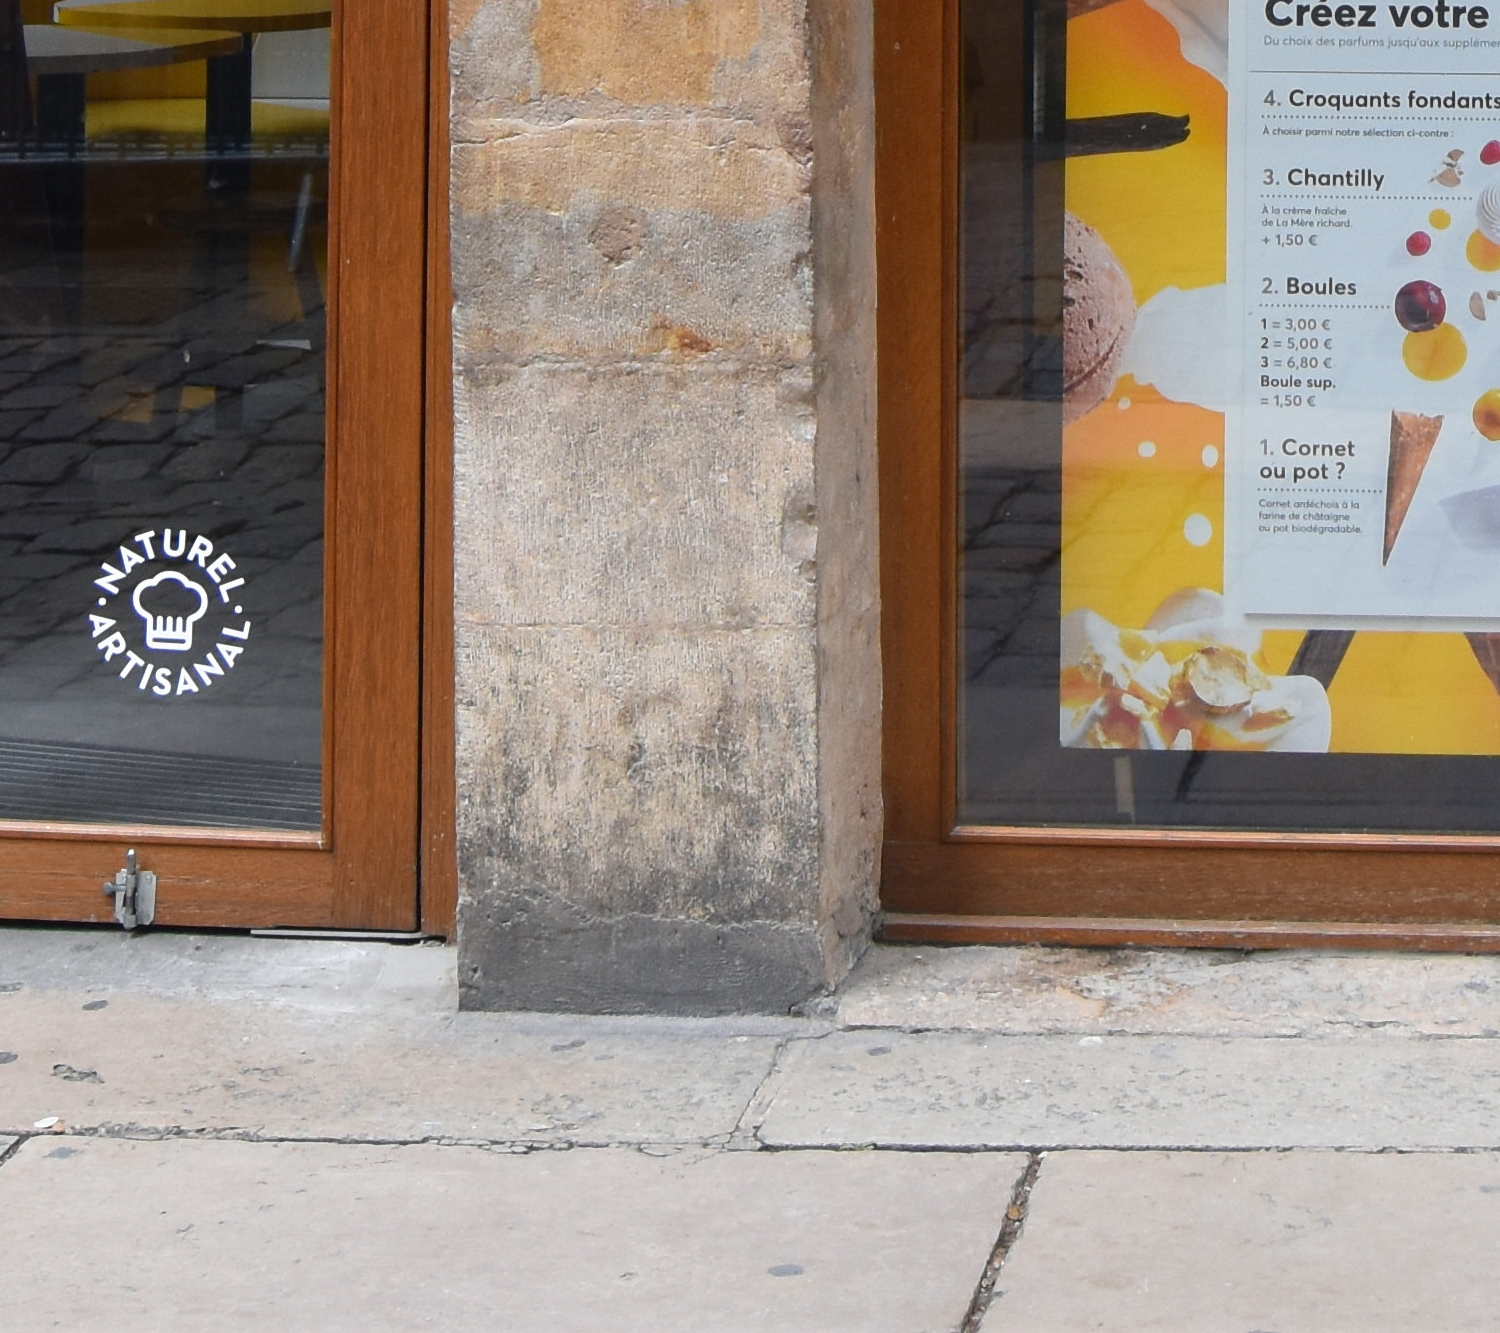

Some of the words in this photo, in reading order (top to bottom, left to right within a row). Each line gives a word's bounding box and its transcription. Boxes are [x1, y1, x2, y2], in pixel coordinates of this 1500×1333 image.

[1388, 0, 1489, 28] votre
[1263, 89, 1282, 107] 4.
[1288, 88, 1401, 112] Croquants
[1262, 168, 1280, 186] 3.
[1287, 167, 1385, 192] Chantilly
[1261, 276, 1279, 294] 2.
[1286, 276, 1357, 296] Boules
[1259, 438, 1274, 456] 1.
[1281, 438, 1356, 458] Cornet
[1259, 466, 1286, 479] ou
[1293, 463, 1329, 484] pot
[1335, 461, 1346, 480] ?
[93, 527, 246, 604] NATUREL
[88, 613, 252, 697] ARTISANAL
